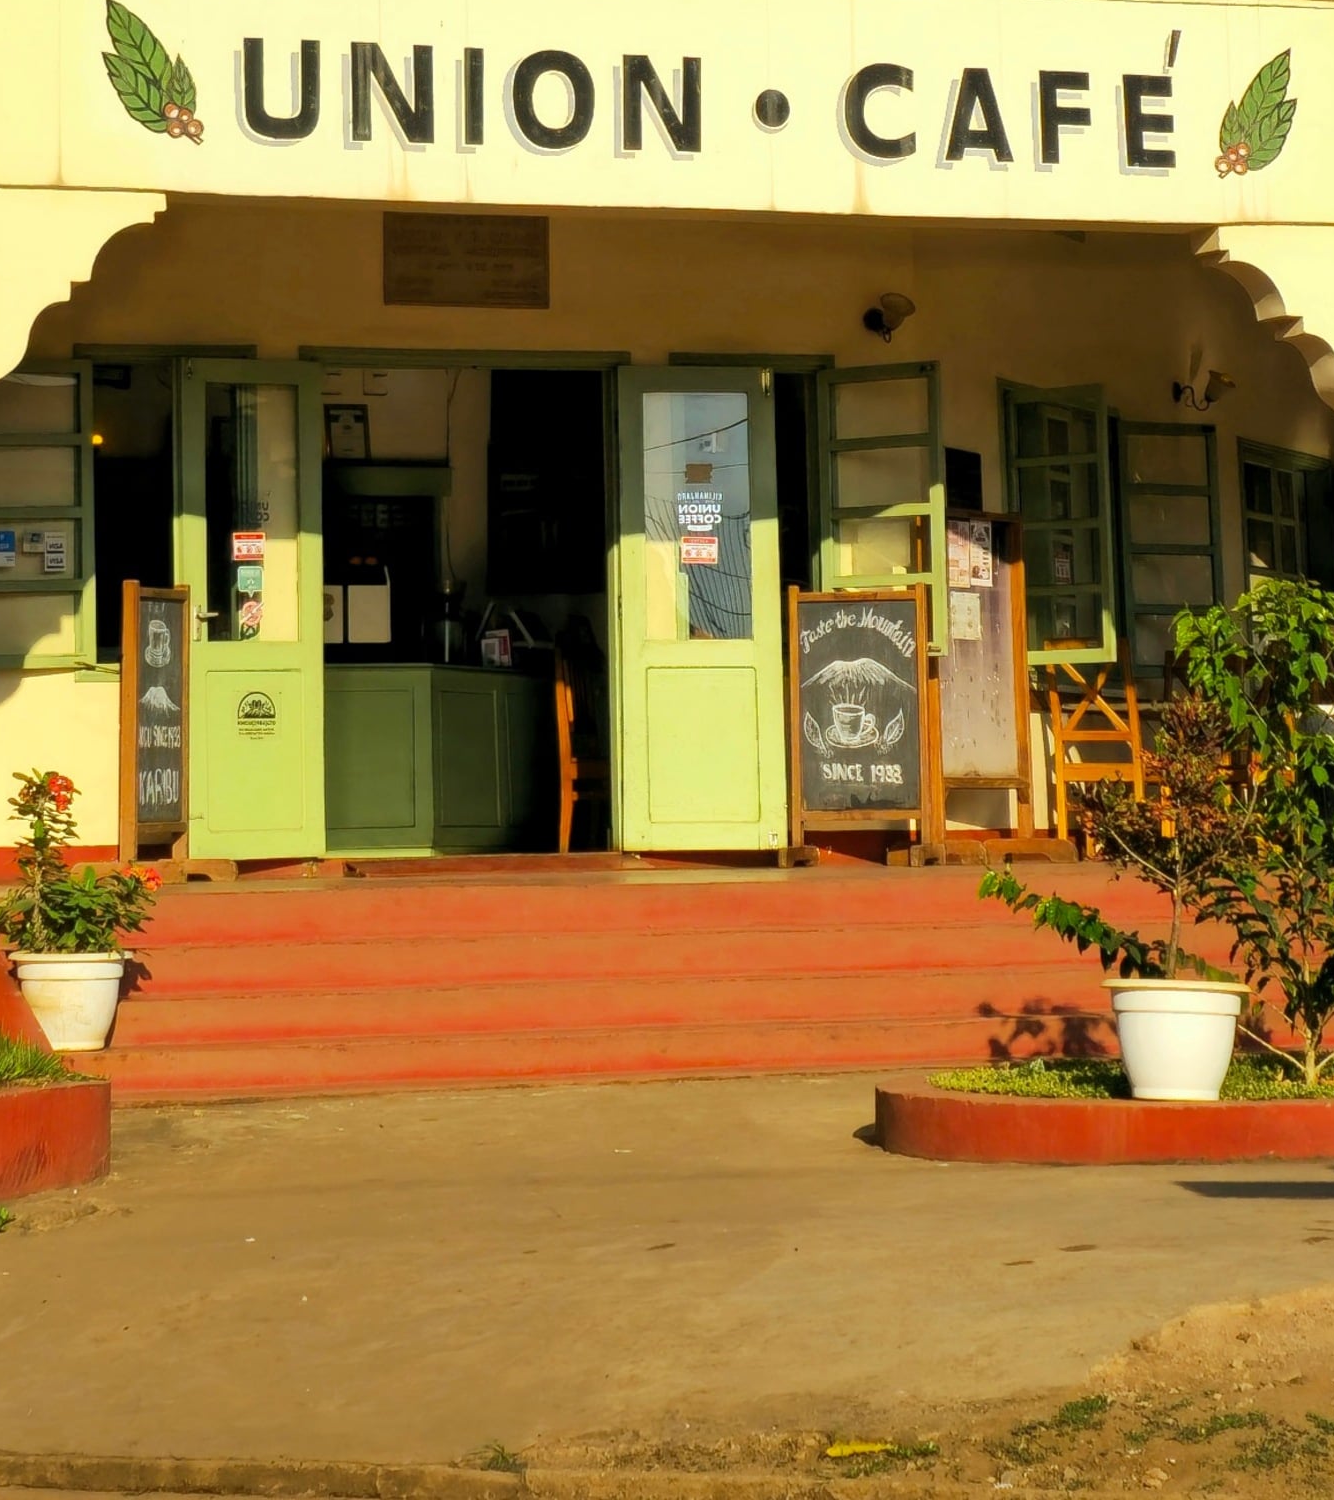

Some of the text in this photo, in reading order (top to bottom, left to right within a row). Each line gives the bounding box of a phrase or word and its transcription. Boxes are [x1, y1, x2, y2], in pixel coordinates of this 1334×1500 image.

[234, 30, 1182, 176] UNION CAFÉ
[800, 606, 916, 658] Taste the Mountain
[139, 768, 179, 806] KARIBU
[822, 762, 864, 782] SINCE
